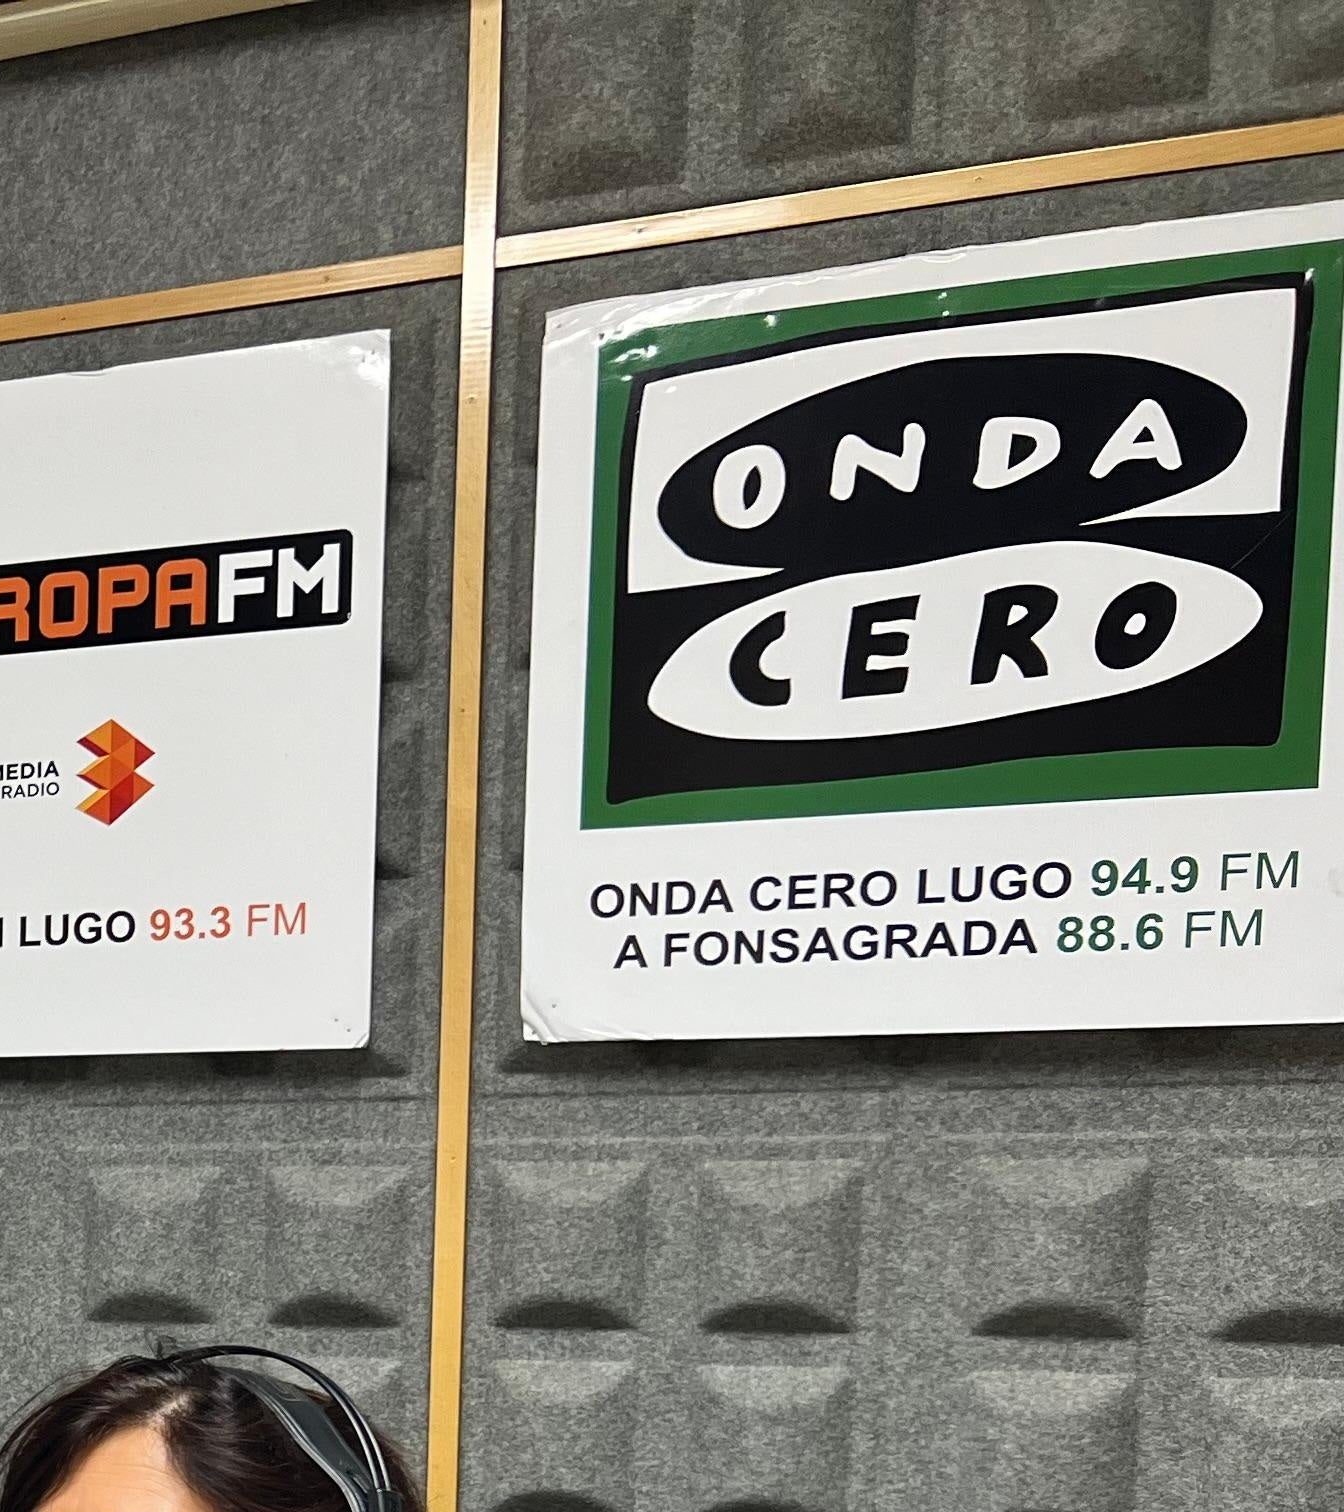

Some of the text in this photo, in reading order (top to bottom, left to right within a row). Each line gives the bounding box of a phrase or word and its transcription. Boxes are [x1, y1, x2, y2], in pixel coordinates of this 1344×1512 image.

[712, 399, 1183, 531] ONDA
[728, 581, 1178, 707] CERO
[2, 783, 61, 800] RADIO
[591, 851, 1300, 920] ONDA CERO LUGO 94.9 FM
[20, 911, 137, 948] LUGO
[151, 907, 232, 942] 93.3
[248, 903, 307, 938] FM
[614, 909, 1264, 970] A FONSAGRADA 88.6 FM
